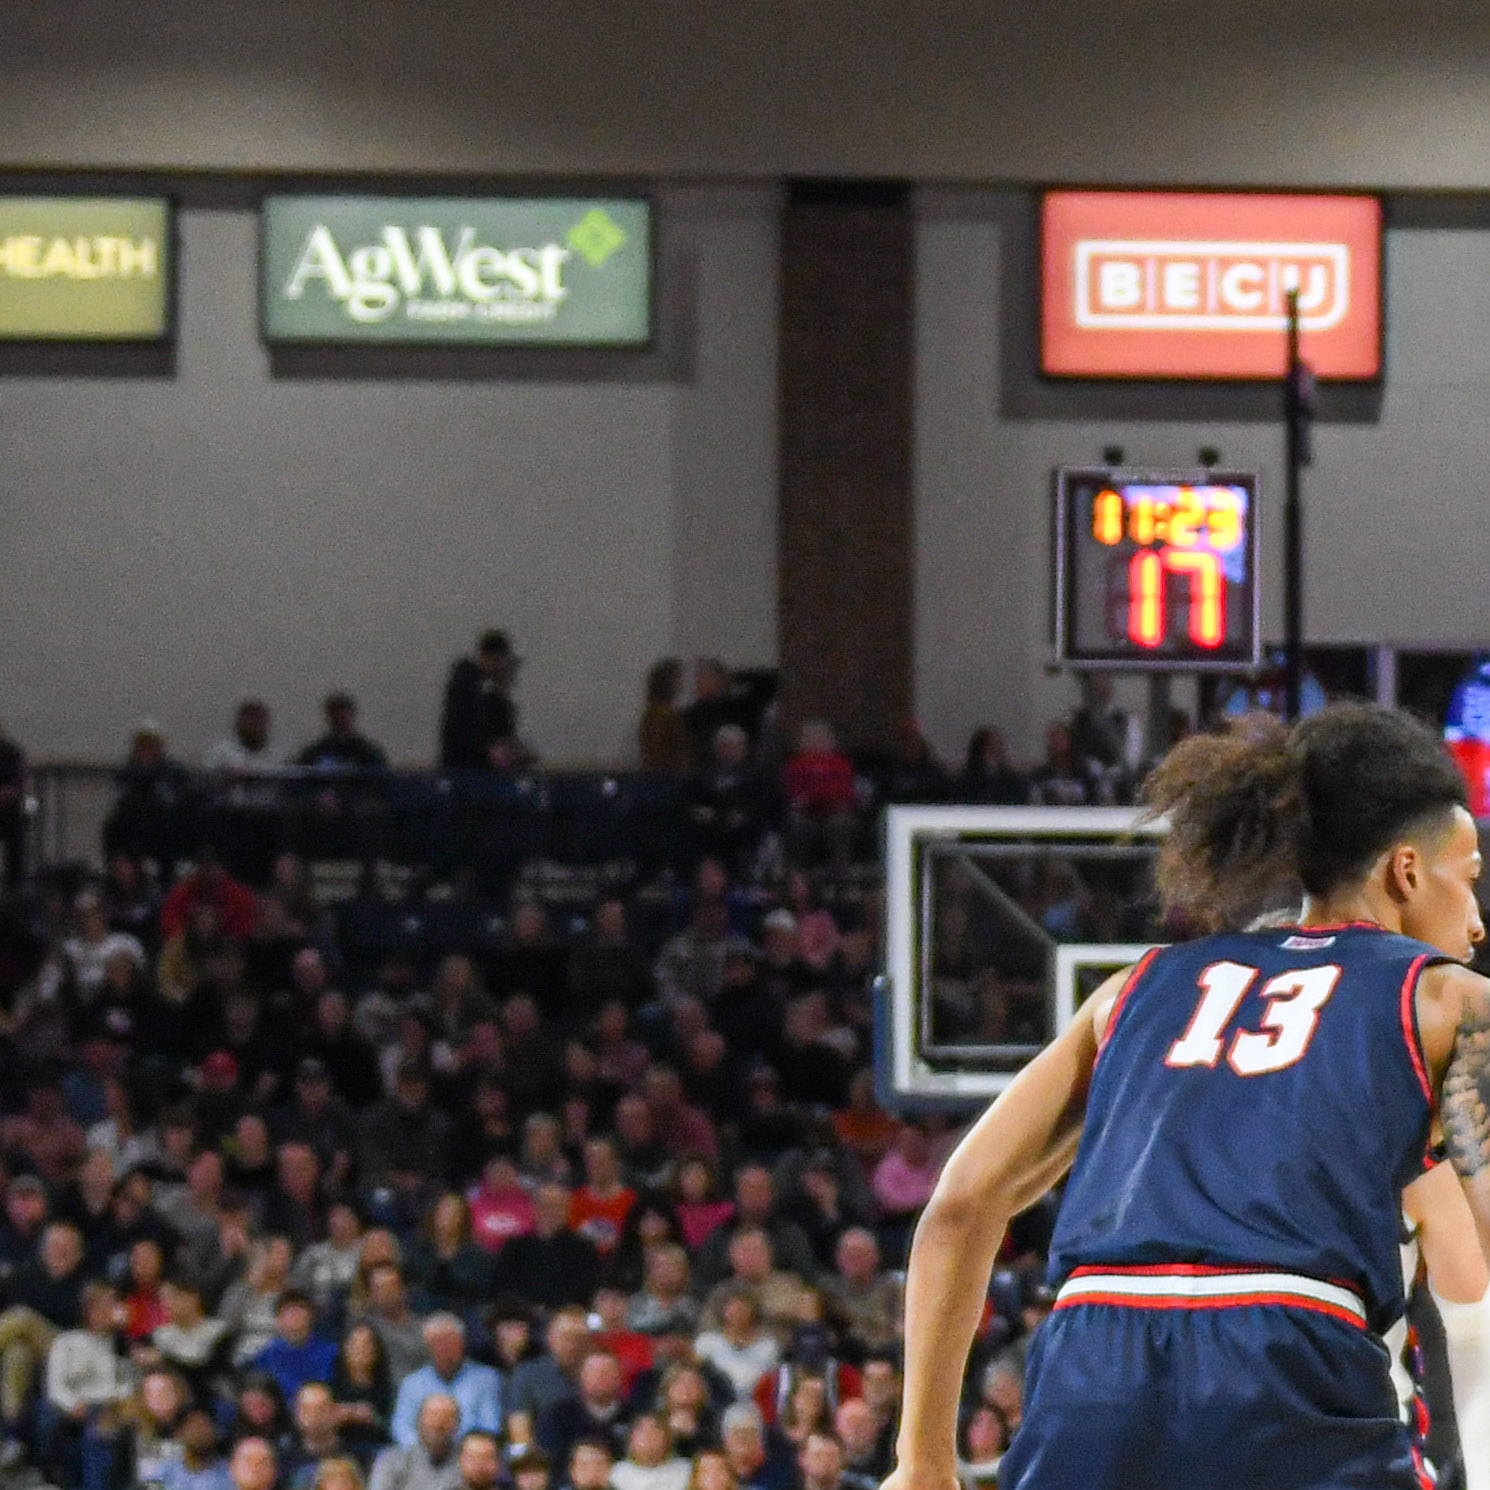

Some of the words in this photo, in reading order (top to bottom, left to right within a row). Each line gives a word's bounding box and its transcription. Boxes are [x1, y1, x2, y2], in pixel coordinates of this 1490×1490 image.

[285, 225, 571, 323] AgWest
[1100, 261, 1326, 310] BECU
[1093, 487, 1243, 550] 11:23
[1128, 547, 1225, 648] 17
[1165, 960, 1342, 1077] 13
